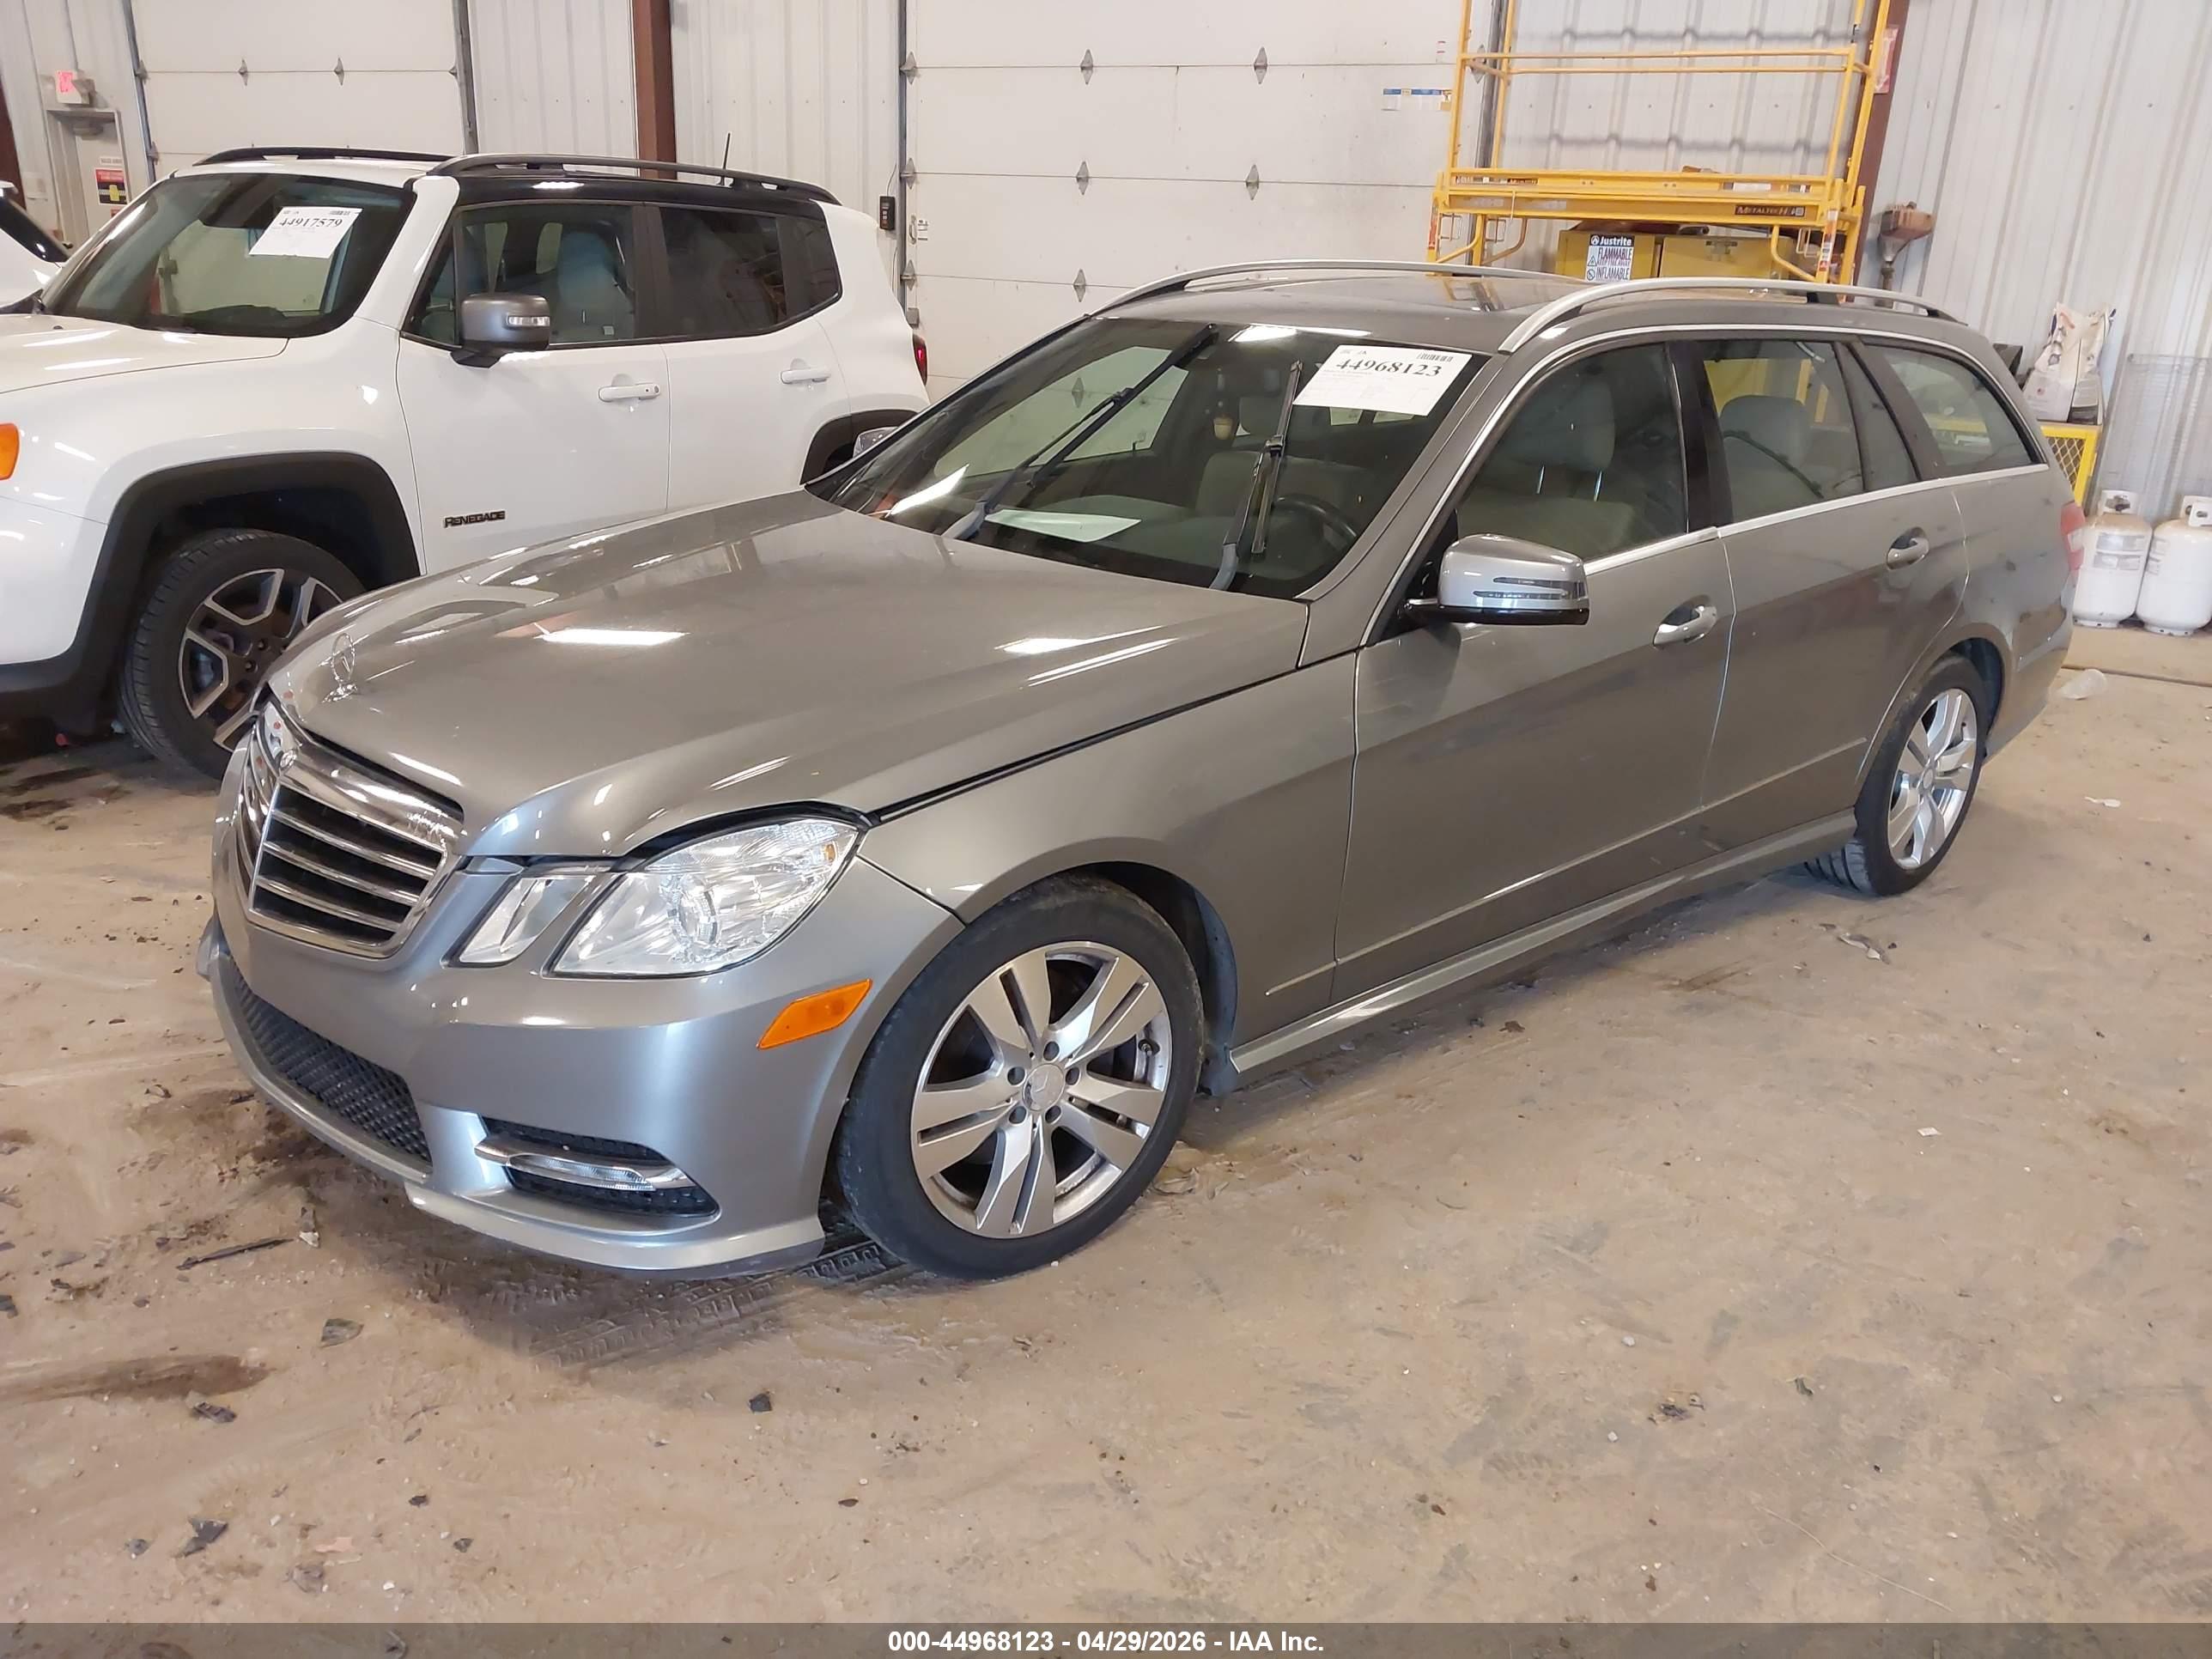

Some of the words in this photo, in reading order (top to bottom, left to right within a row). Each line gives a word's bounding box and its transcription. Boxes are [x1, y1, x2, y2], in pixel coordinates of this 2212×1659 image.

[278, 217, 343, 228] 44917579
[1600, 236, 1632, 246] Justrite
[1598, 246, 1632, 260] FLAMMABLE
[1336, 359, 1442, 377] 44968123
[444, 510, 506, 528] RENEGADE
